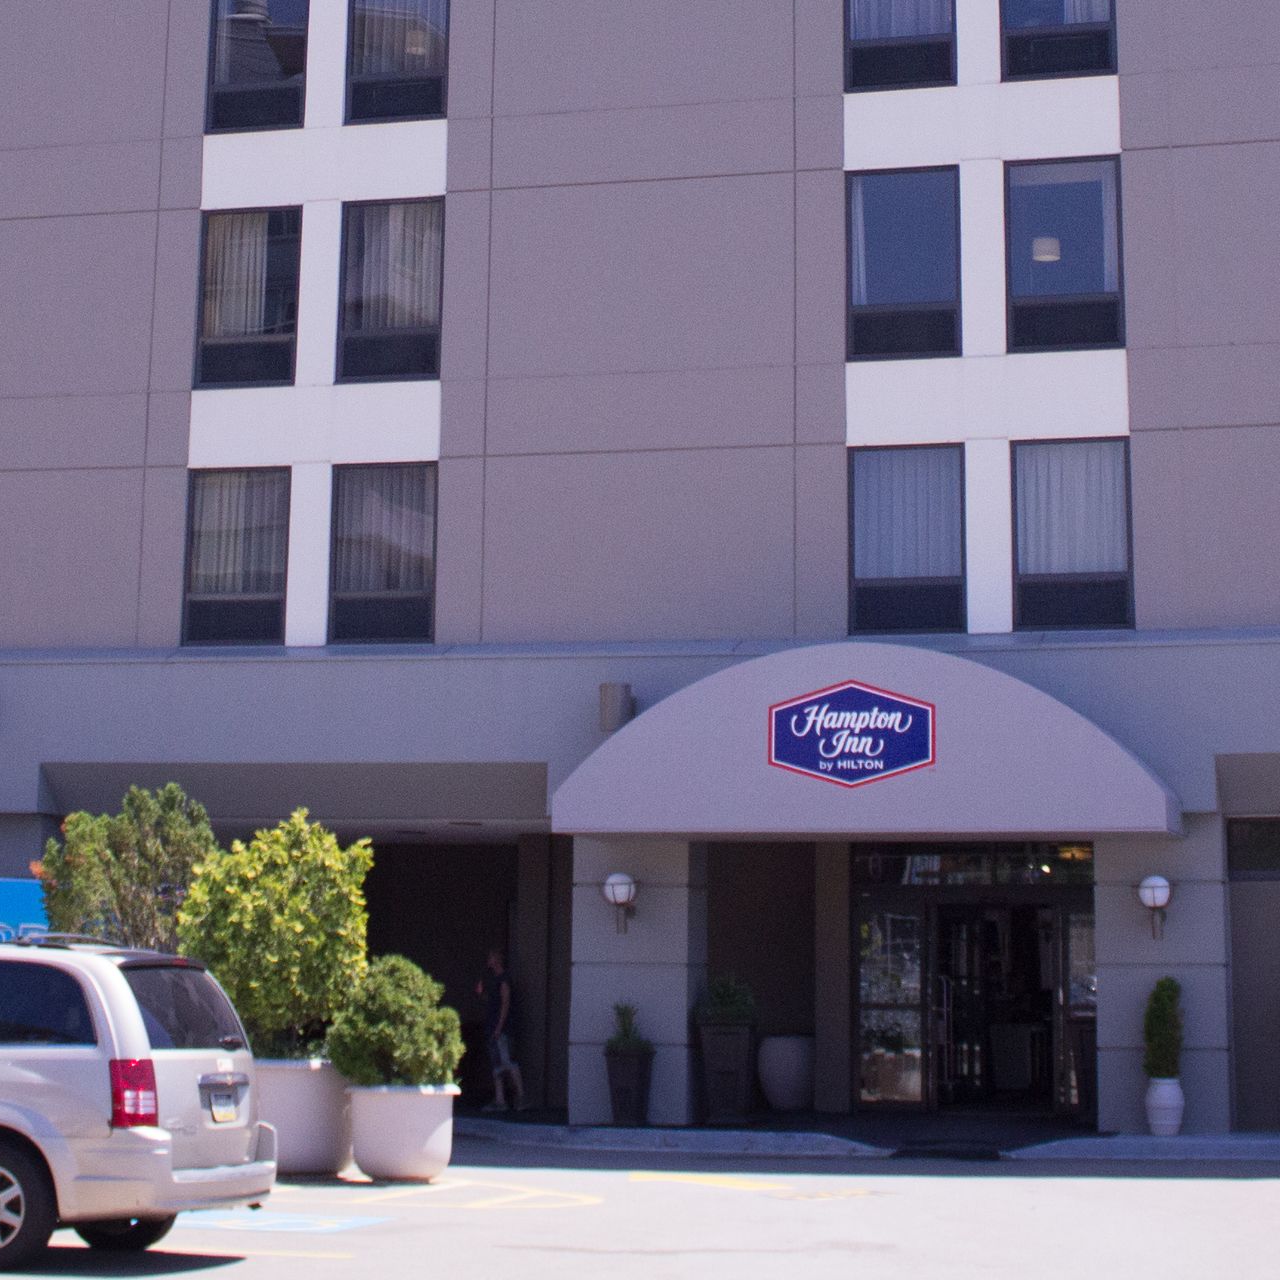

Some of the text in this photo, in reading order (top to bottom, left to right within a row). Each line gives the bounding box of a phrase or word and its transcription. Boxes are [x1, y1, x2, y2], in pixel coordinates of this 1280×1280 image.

[791, 704, 913, 737] Hampton
[819, 730, 884, 758] Inn
[820, 759, 884, 772] by HILTON
